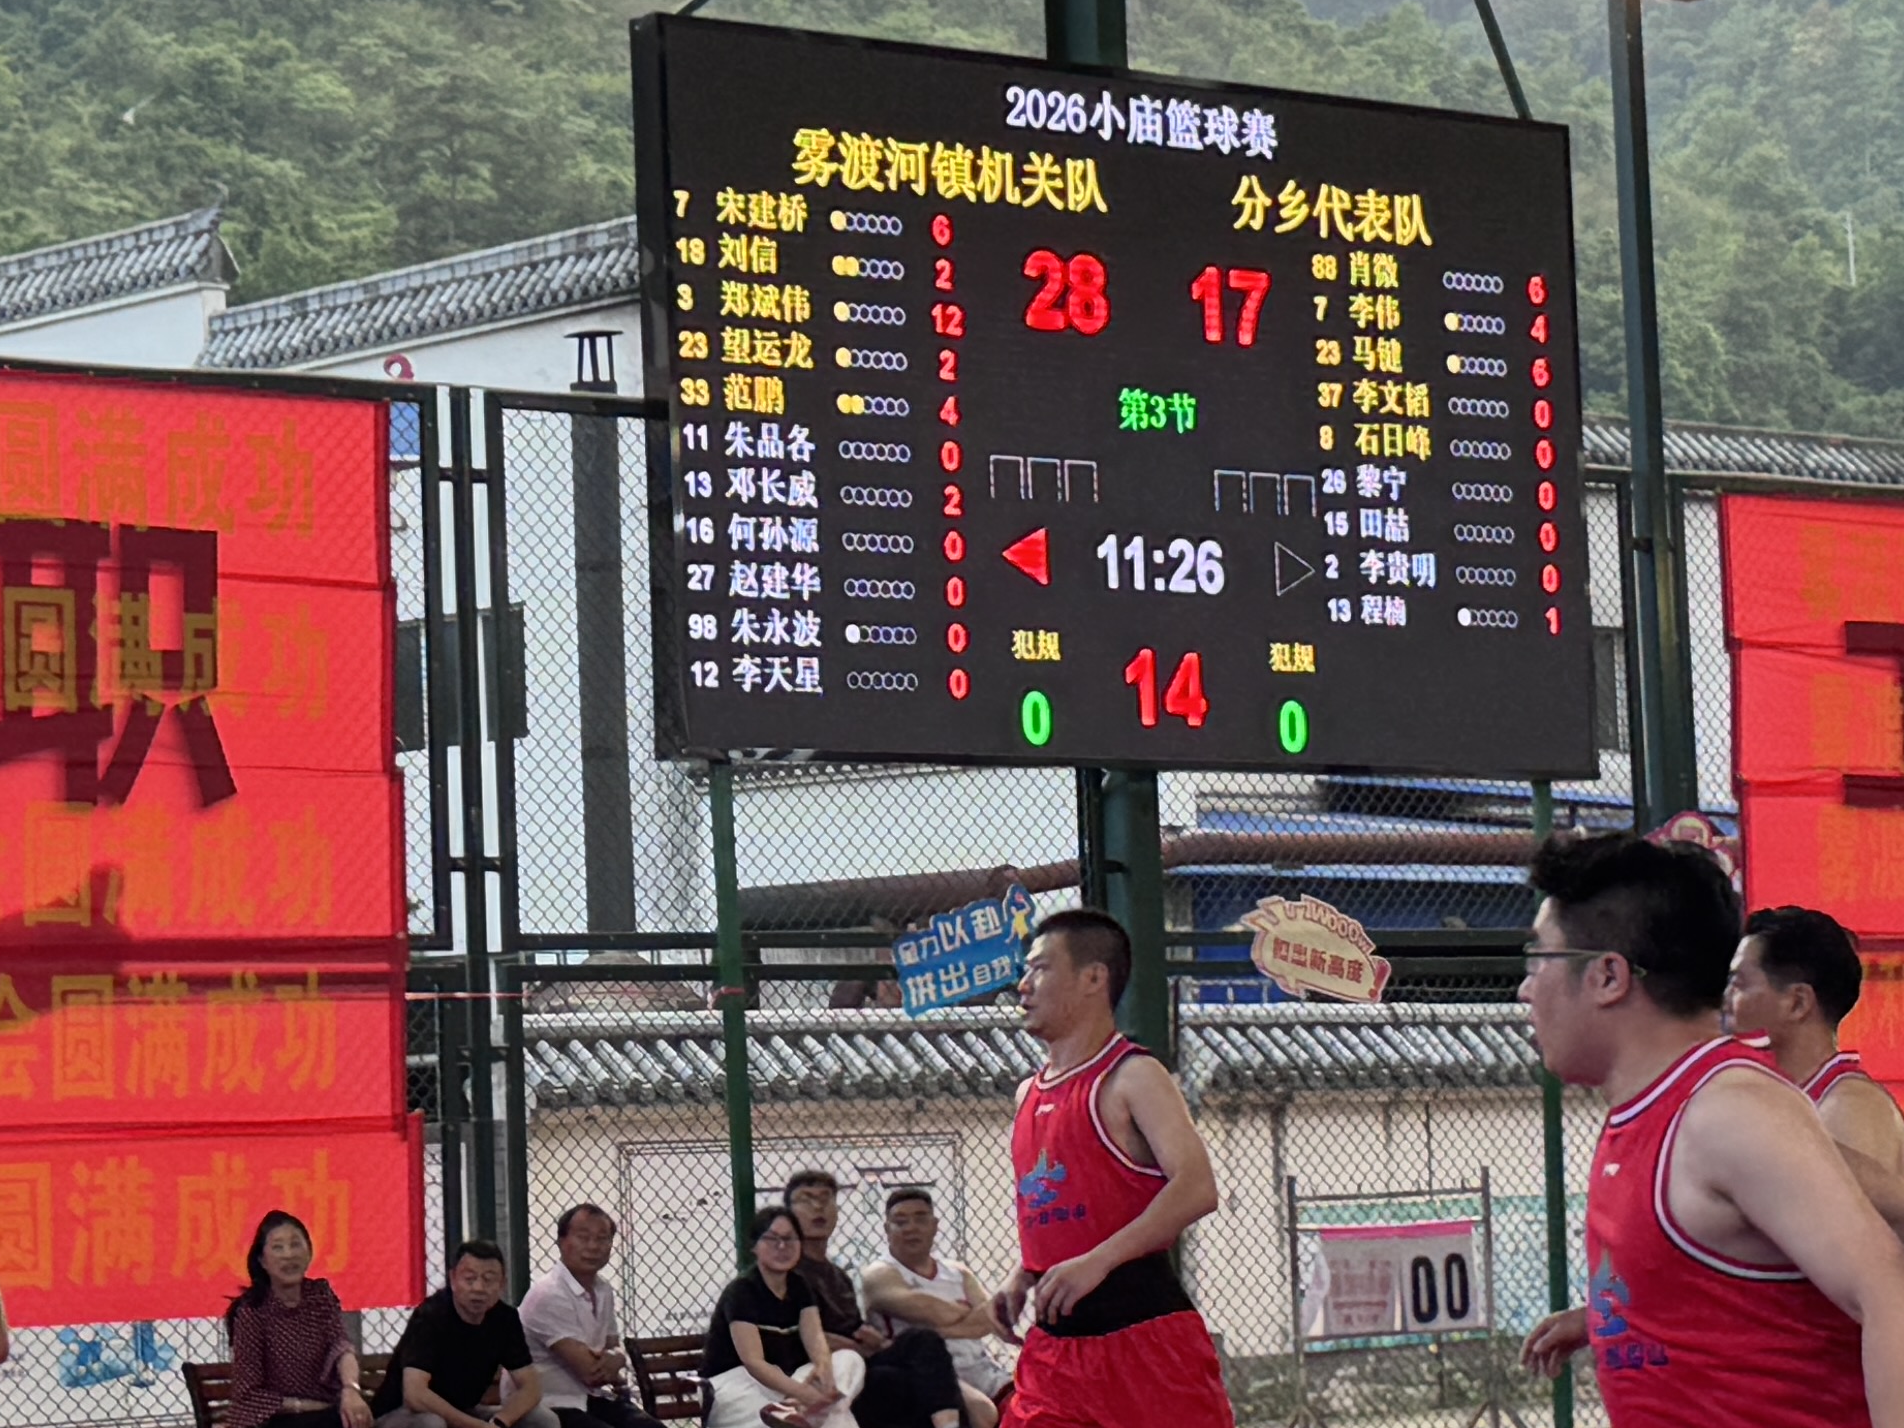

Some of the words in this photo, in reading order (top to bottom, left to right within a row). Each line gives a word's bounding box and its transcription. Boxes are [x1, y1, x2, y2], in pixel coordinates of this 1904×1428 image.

[1005, 85, 1280, 160] 2026小庙篮球赛
[791, 126, 1109, 215] 雾渡河镇机关队
[673, 189, 691, 219] 7
[715, 186, 809, 234] 宋建桥
[931, 214, 954, 246] 6
[1230, 174, 1434, 248] 分乡代表队
[675, 236, 707, 266] 18
[717, 231, 779, 275] 刘信
[934, 258, 955, 291] 2
[1311, 253, 1339, 282] 88
[1527, 275, 1547, 306] 6
[676, 282, 695, 312] 3
[720, 279, 812, 324] 郑斌伟
[930, 303, 967, 338] 12
[1022, 248, 1112, 337] 28
[1190, 264, 1274, 349] 17
[1313, 295, 1330, 323] 7
[1349, 292, 1402, 332] 李伟
[1529, 314, 1550, 345] 4
[678, 329, 710, 360] 23
[721, 325, 815, 370] 望运龙
[938, 348, 959, 382] 2
[1315, 338, 1343, 367] 23
[1531, 356, 1552, 389] 6
[679, 376, 712, 407] 33
[723, 371, 786, 416] 范鹏
[939, 395, 963, 428] 4
[1118, 387, 1196, 435] 第3节
[1317, 381, 1345, 409] 37
[1533, 398, 1554, 429] 0
[683, 422, 709, 453] 11
[940, 440, 963, 472] 0
[1319, 424, 1336, 452] 8
[1535, 438, 1554, 471] 0
[684, 470, 713, 499] 13
[725, 466, 819, 509] 邓长威
[943, 484, 963, 517] 2
[1321, 468, 1348, 496] 26
[1537, 480, 1556, 511] 0
[686, 516, 715, 545] 16
[944, 530, 966, 562] 0
[1323, 510, 1350, 537] 15
[1539, 522, 1559, 554] 0
[687, 564, 716, 592] 27
[728, 559, 822, 602] 赵建华
[946, 576, 967, 607] 0
[1096, 533, 1226, 596] 11:26
[1324, 553, 1340, 581] 2
[1541, 563, 1562, 594] 0
[688, 613, 719, 642] 98
[730, 607, 823, 649] 朱永波
[947, 622, 969, 654] 0
[1327, 597, 1353, 624] 13
[1544, 606, 1563, 636] 1
[1010, 628, 1062, 662] 犯规
[1269, 641, 1317, 674] 犯规
[690, 660, 720, 689] 12
[732, 653, 824, 695] 李天星
[949, 668, 971, 700] 0
[1123, 647, 1210, 729] 14
[1020, 689, 1054, 748] 0
[1278, 699, 1310, 755] 0
[1411, 1252, 1470, 1323] 00
